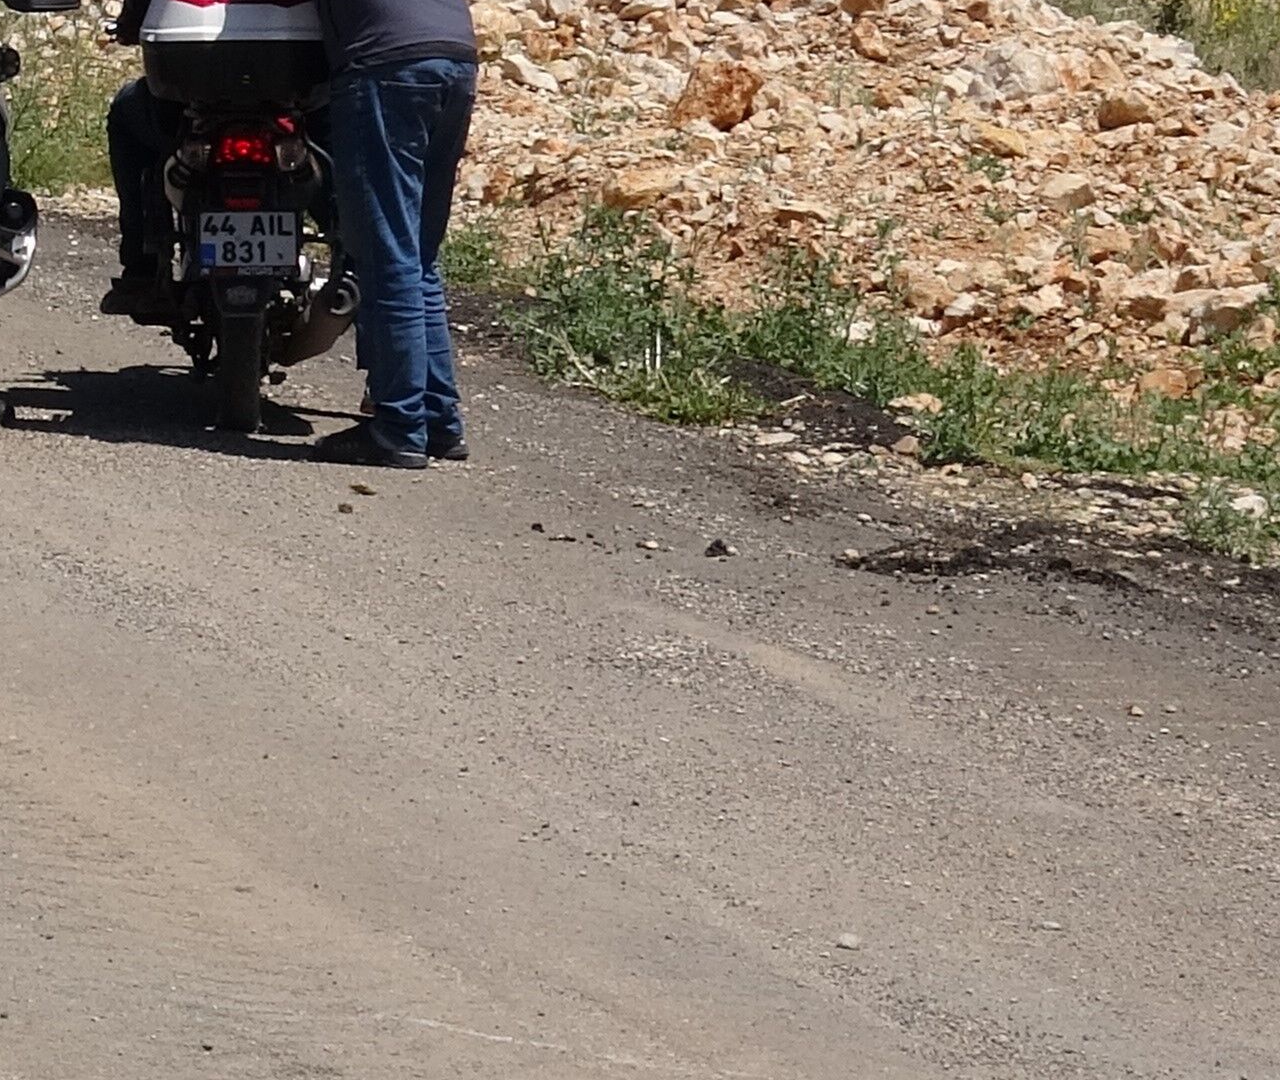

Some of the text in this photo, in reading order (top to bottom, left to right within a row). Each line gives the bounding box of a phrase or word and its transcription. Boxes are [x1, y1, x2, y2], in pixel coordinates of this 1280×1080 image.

[203, 214, 293, 236] 44 AIL
[222, 240, 266, 263] 831
